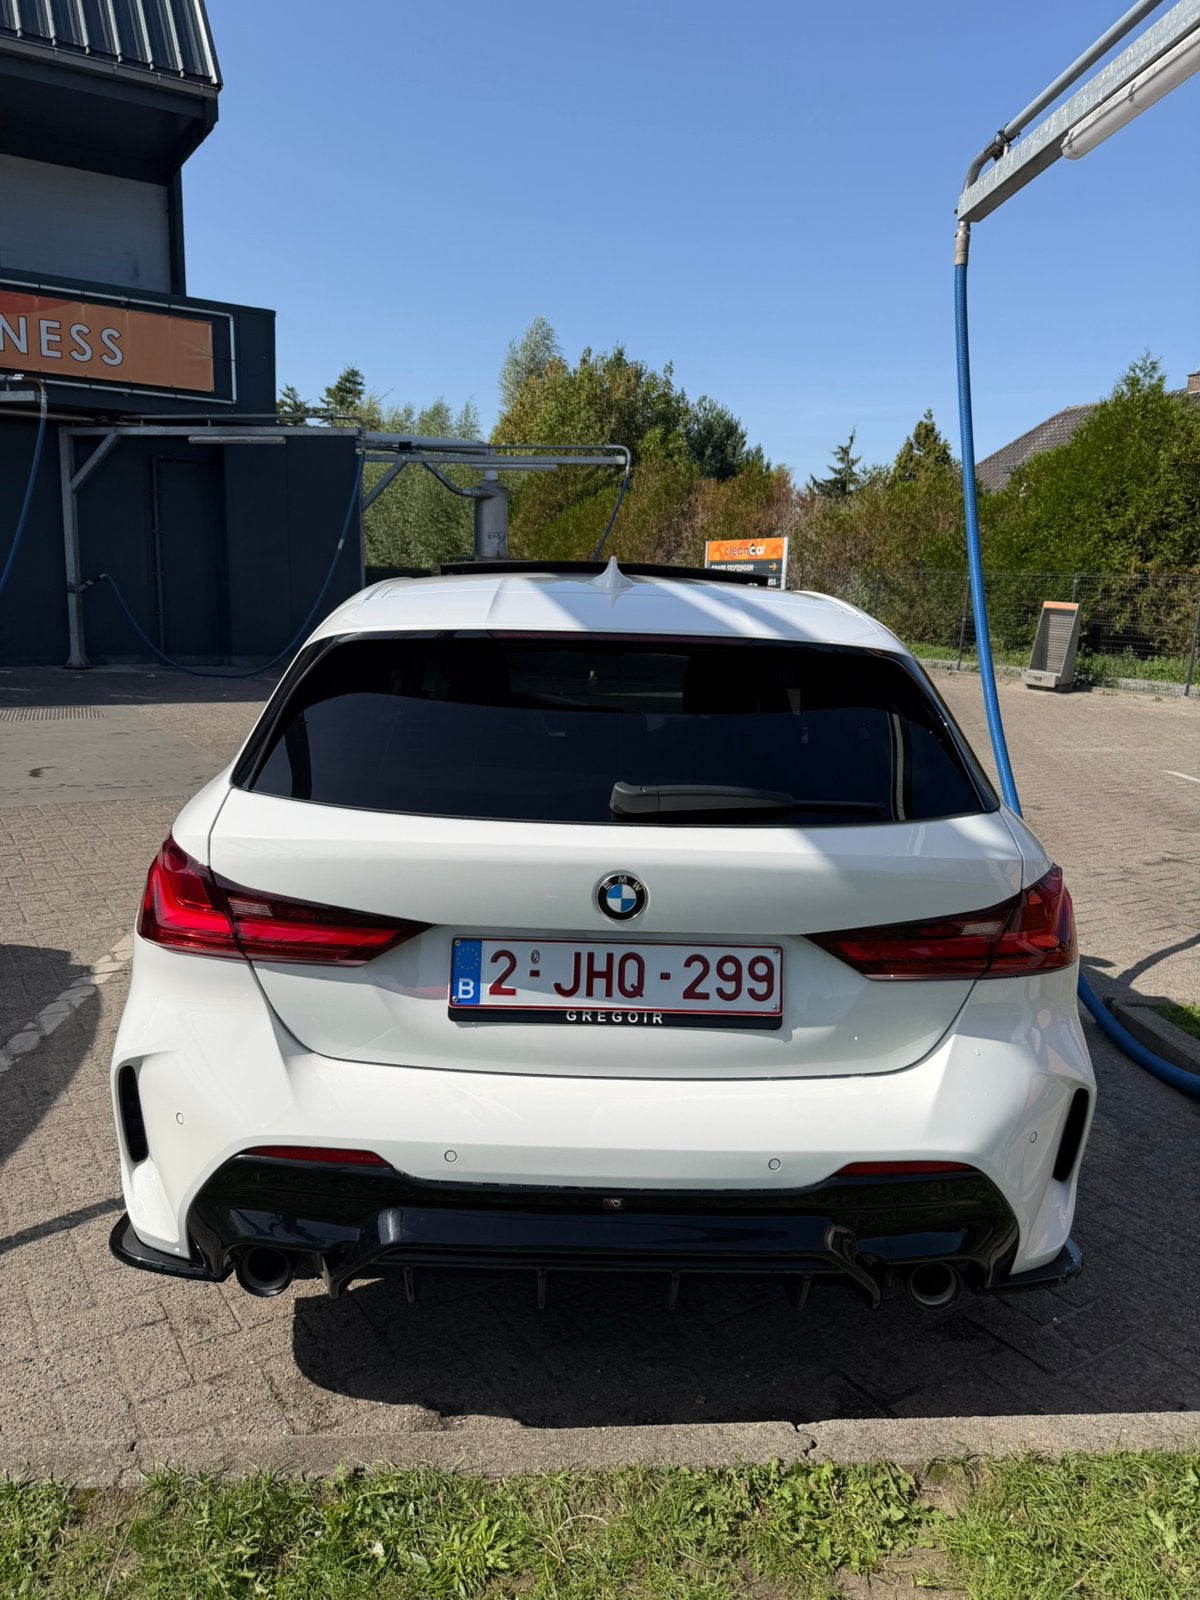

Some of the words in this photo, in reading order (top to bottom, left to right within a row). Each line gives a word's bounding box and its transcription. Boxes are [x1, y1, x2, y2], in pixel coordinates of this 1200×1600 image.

[0, 313, 123, 366] NESS
[602, 876, 643, 891] BMW
[457, 978, 474, 999] B
[566, 1010, 663, 1024] GREGOIR
